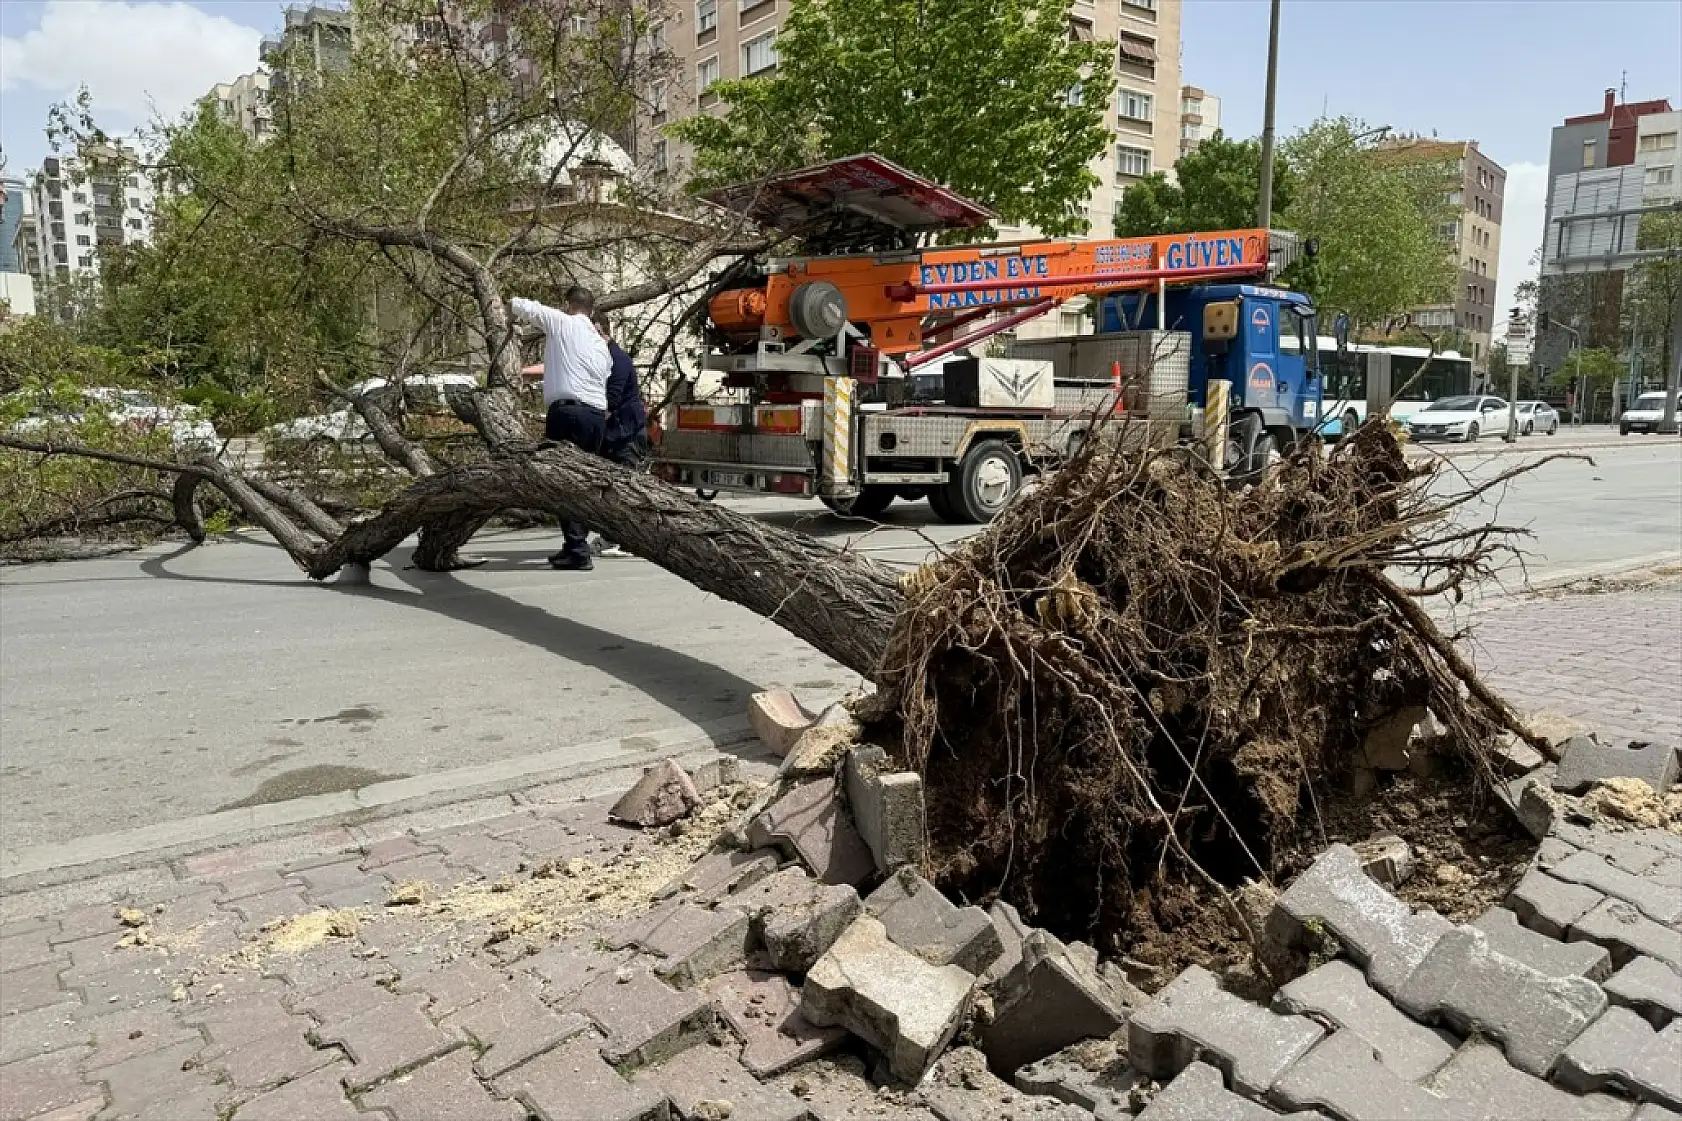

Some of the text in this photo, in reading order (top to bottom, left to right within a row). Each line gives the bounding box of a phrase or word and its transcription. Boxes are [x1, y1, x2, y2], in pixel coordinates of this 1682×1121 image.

[1167, 236, 1243, 269] GÜVEN
[920, 255, 1049, 285] EVDEN EVE
